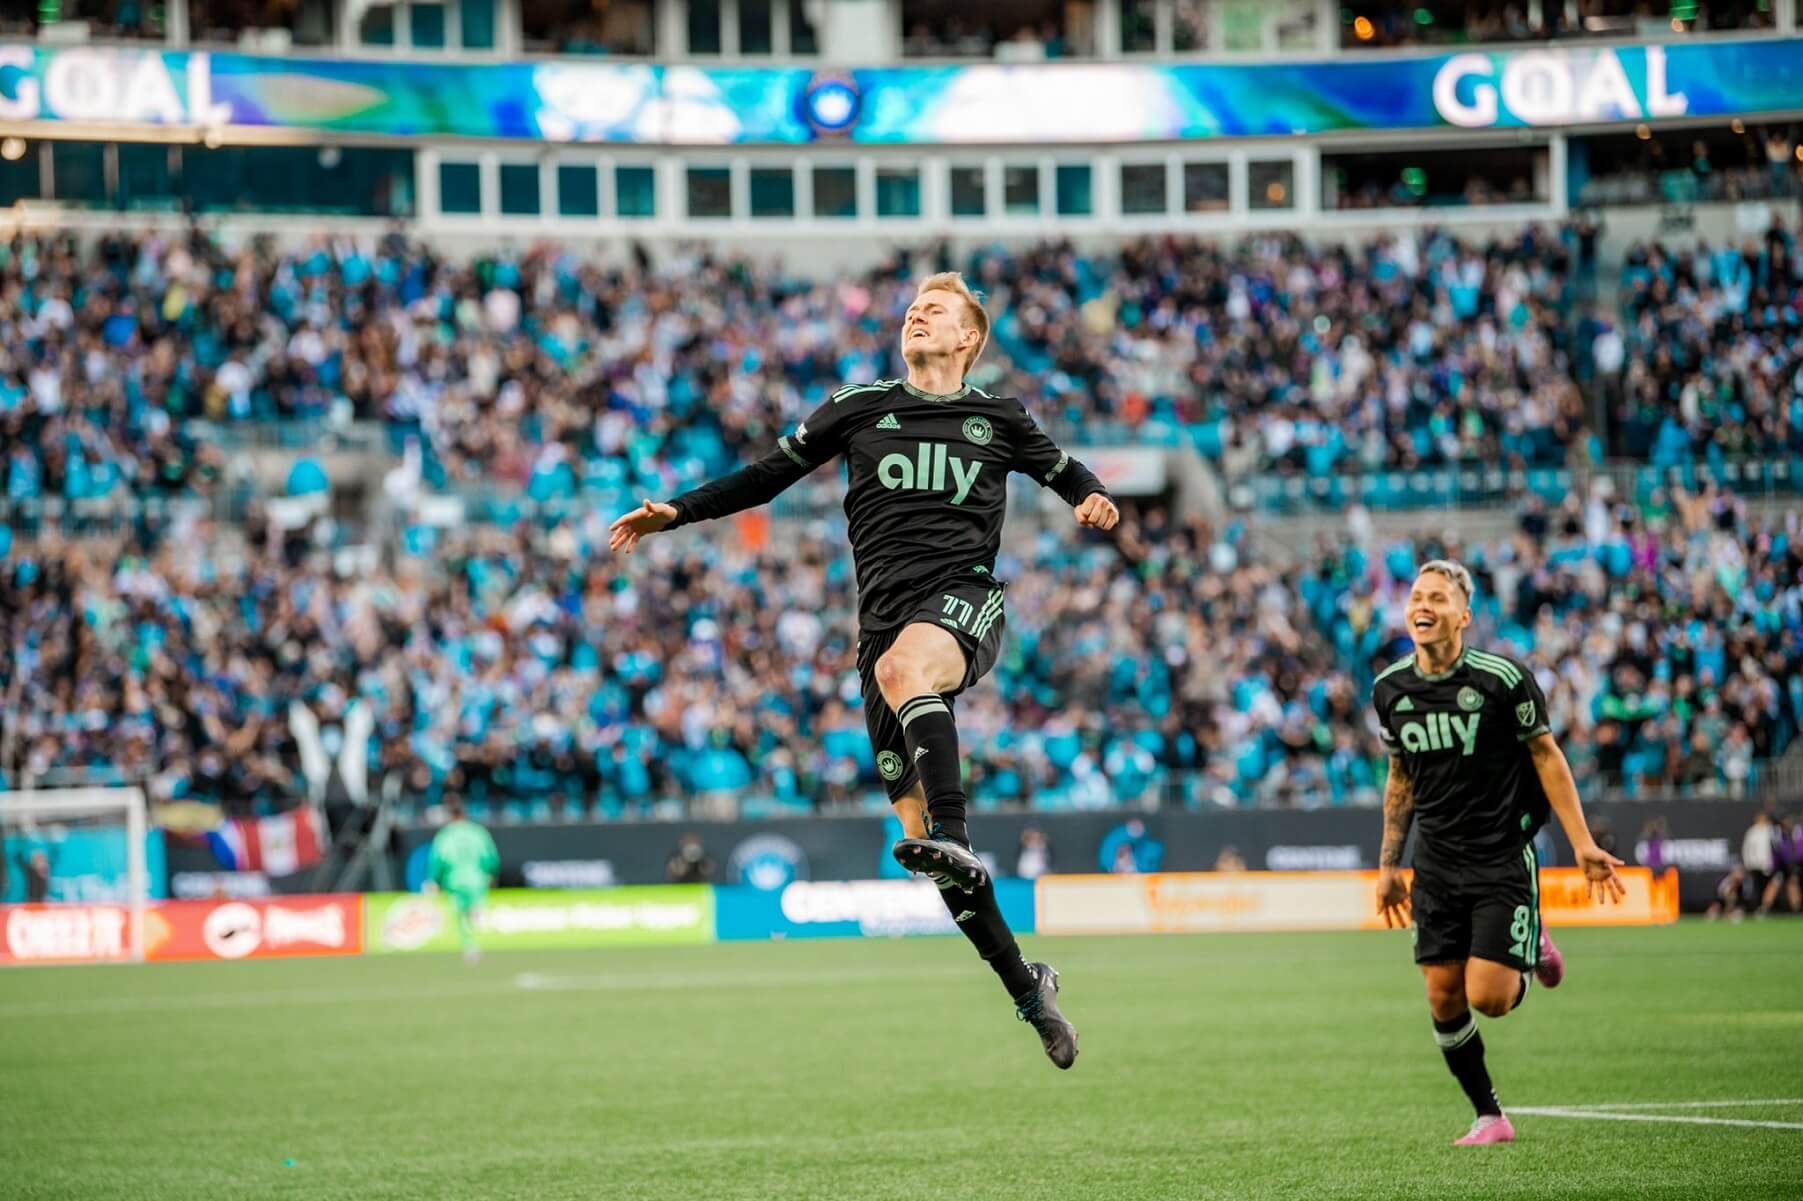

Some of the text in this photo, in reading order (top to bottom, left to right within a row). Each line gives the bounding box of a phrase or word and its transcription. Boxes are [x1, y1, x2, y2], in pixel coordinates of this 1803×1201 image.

[0, 45, 233, 124] GOAL
[1433, 45, 1688, 127] GOAL
[877, 442, 982, 506] ally
[1400, 712, 1481, 756] ally
[1510, 905, 1530, 943] 8
